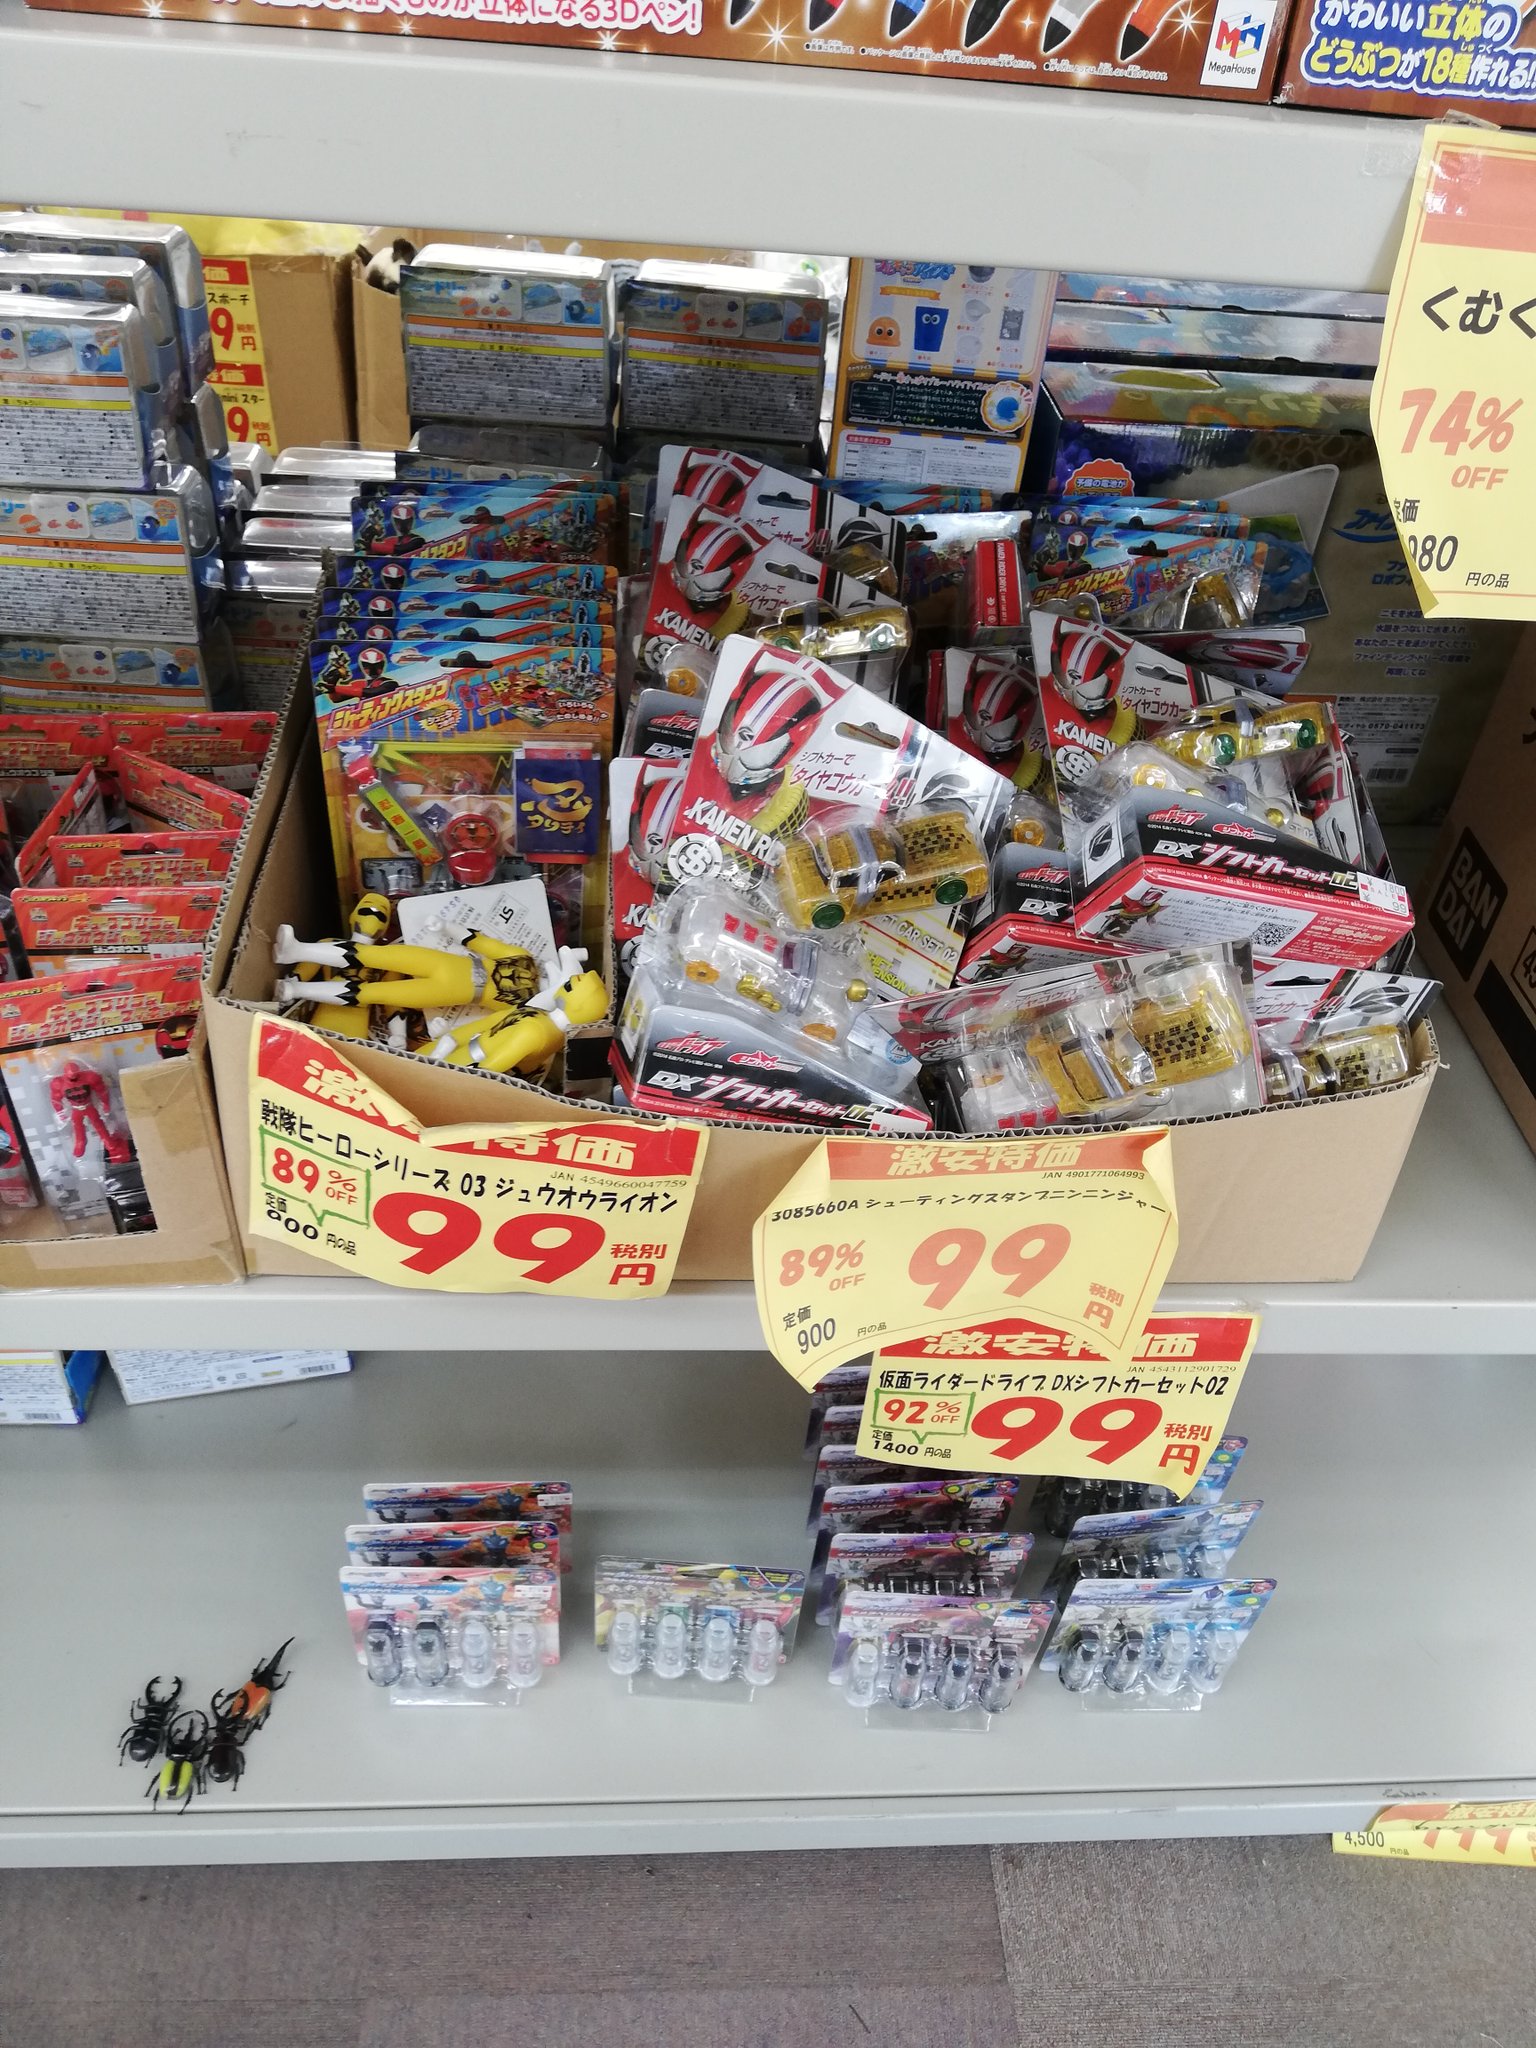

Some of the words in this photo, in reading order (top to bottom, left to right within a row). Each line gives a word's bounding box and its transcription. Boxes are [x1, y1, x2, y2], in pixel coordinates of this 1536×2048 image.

[1320, 0, 1511, 43] かわいい立体の
[1208, 61, 1256, 74] MegaHouse
[241, 336, 257, 351] 円
[1400, 387, 1524, 456] 74%
[256, 432, 272, 447] 円
[1451, 465, 1509, 490] OFF
[1465, 571, 1511, 589] 円の品
[654, 608, 716, 648] KAMEN
[1121, 686, 1160, 698] シフトカーで
[645, 742, 692, 759] DX
[1053, 720, 1118, 757] KAMEN
[800, 751, 855, 765] シフトカーで
[684, 797, 758, 853] KAMEN
[1152, 839, 1202, 859] DX
[1200, 842, 1332, 885] シフトカーセット
[1384, 882, 1406, 896] 1800
[1451, 846, 1498, 931] BAN
[1018, 898, 1068, 917] DX
[1392, 901, 1407, 914] 99
[1436, 879, 1476, 951] DAI
[897, 921, 920, 943] CAR
[921, 935, 944, 955] SET
[942, 947, 959, 963] 02
[646, 1070, 704, 1092] DX
[699, 1073, 845, 1118] シフトカーセット
[261, 1098, 450, 1192] 戦隊ヒーローシリーズ
[460, 1172, 486, 1197] 03
[495, 1177, 678, 1214] ジュウオウライオン
[886, 1140, 1086, 1177] 激安特価
[272, 1147, 320, 1193] 89
[327, 1170, 358, 1193] %
[550, 1170, 574, 1182] JAN
[579, 1175, 687, 1189] 4549660047759
[1041, 1170, 1063, 1180] JAN
[1065, 1170, 1146, 1181] 4901771064993
[325, 1186, 358, 1205] OFF
[771, 1198, 859, 1222] 3085660A
[865, 1188, 1167, 1214] シューティングスタンプニンニンジャー
[326, 1233, 357, 1257] 円の品
[372, 1191, 607, 1284] 99
[610, 1243, 668, 1260] 税別
[779, 1239, 866, 1287] 89%
[608, 1263, 656, 1286] 円
[908, 1223, 1072, 1311] 99
[828, 1272, 867, 1292] OFF
[1088, 1282, 1125, 1308] 税別
[782, 1305, 812, 1332] 定価
[1082, 1300, 1115, 1330] 円
[797, 1317, 837, 1355] 900
[857, 1322, 888, 1338] 円の品
[1127, 1365, 1145, 1373] JAN
[1149, 1364, 1237, 1374] 4543112901729
[879, 1370, 1047, 1392] 仮面ライダードライブ
[1051, 1373, 1230, 1396] DXシフトカーセット02
[883, 1400, 928, 1424] 92
[935, 1401, 961, 1415] %
[931, 1414, 960, 1424] OFF
[872, 1430, 893, 1441] 定価
[971, 1396, 1163, 1466] 99
[1163, 1423, 1213, 1442] 税別
[874, 1440, 919, 1456] 1400
[923, 1446, 952, 1459] 円の品
[1158, 1444, 1201, 1476] 円
[1344, 1831, 1385, 1848] 4,500
